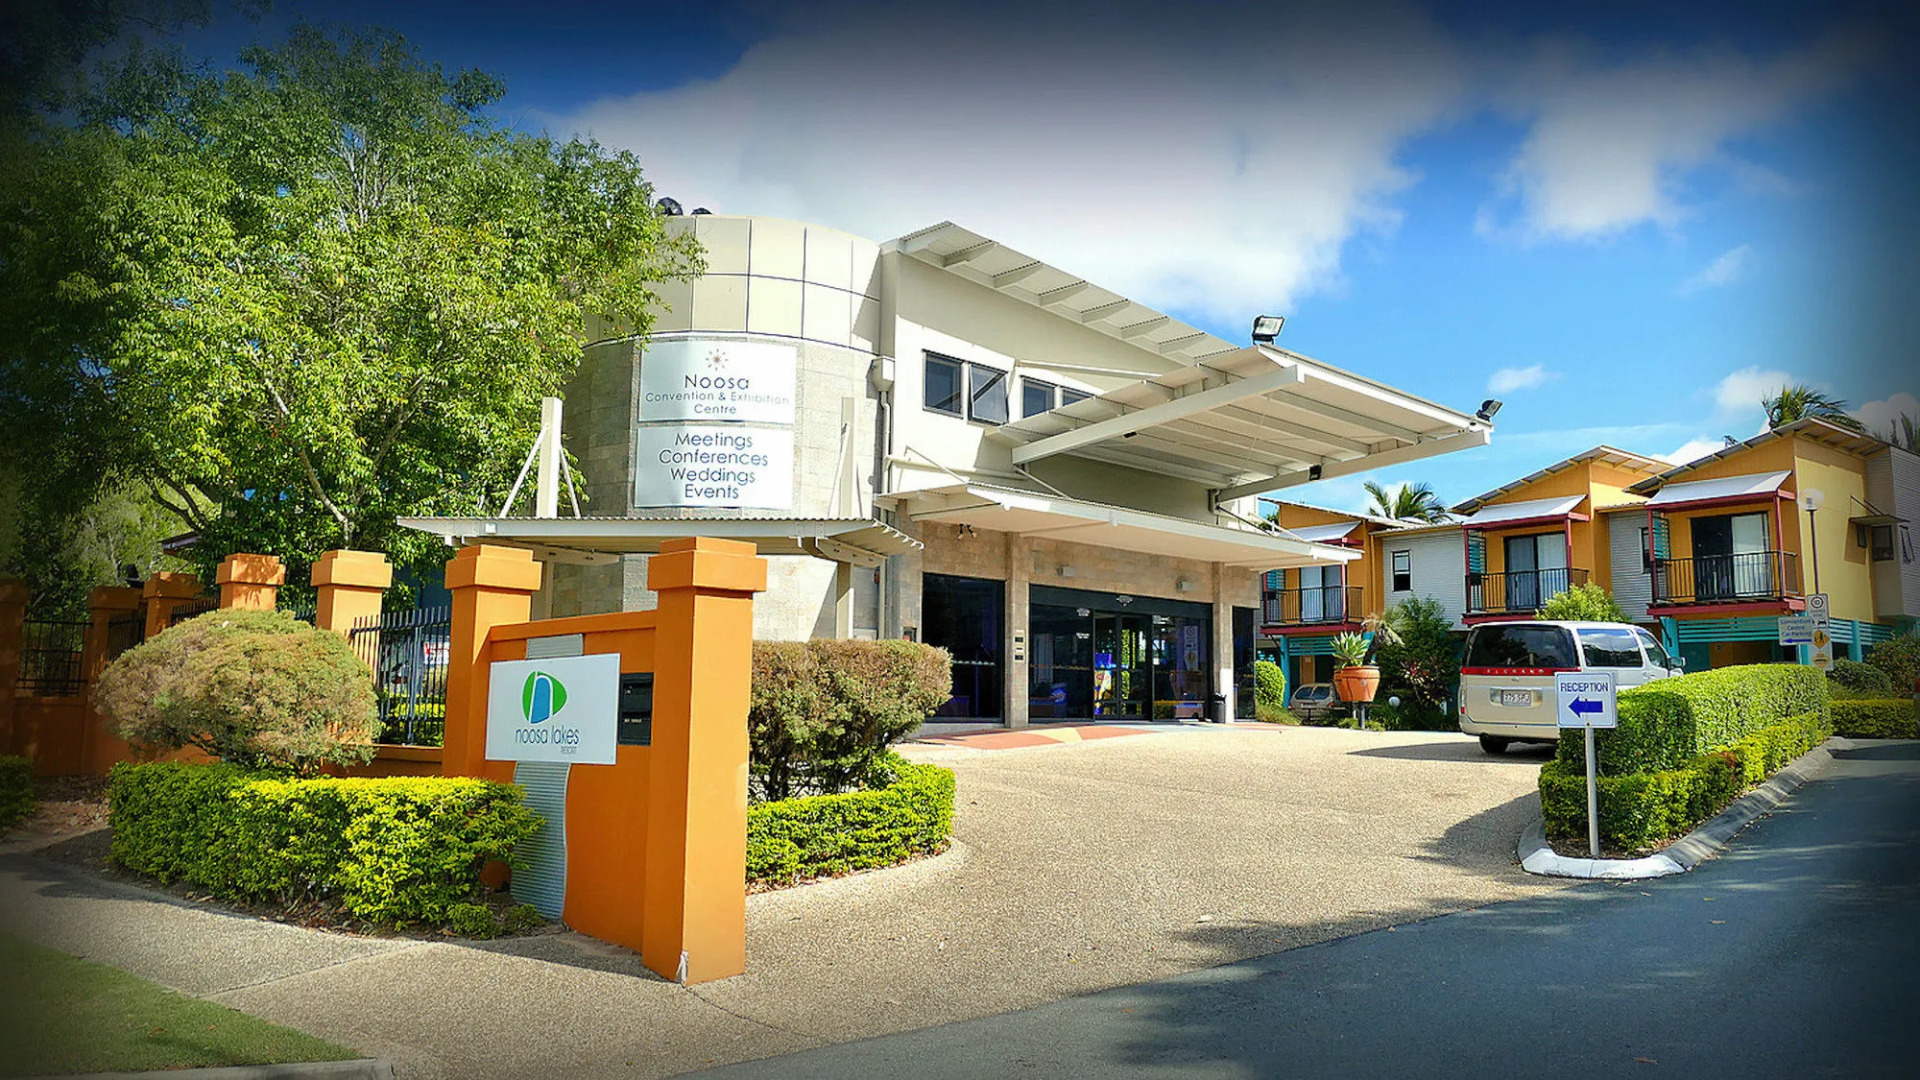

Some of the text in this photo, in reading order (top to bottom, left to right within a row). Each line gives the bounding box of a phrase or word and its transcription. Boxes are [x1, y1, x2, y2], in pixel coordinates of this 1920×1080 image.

[684, 374, 750, 390] Noosa
[645, 391, 789, 404] Convention & Exhibition
[694, 404, 737, 415] Centre
[674, 432, 753, 450] Meetings
[659, 449, 768, 467] Conferences
[670, 467, 755, 486] Weddings
[684, 483, 739, 499] Events
[1560, 682, 1609, 693] RECEPTION
[515, 725, 579, 744] noosa lakes
